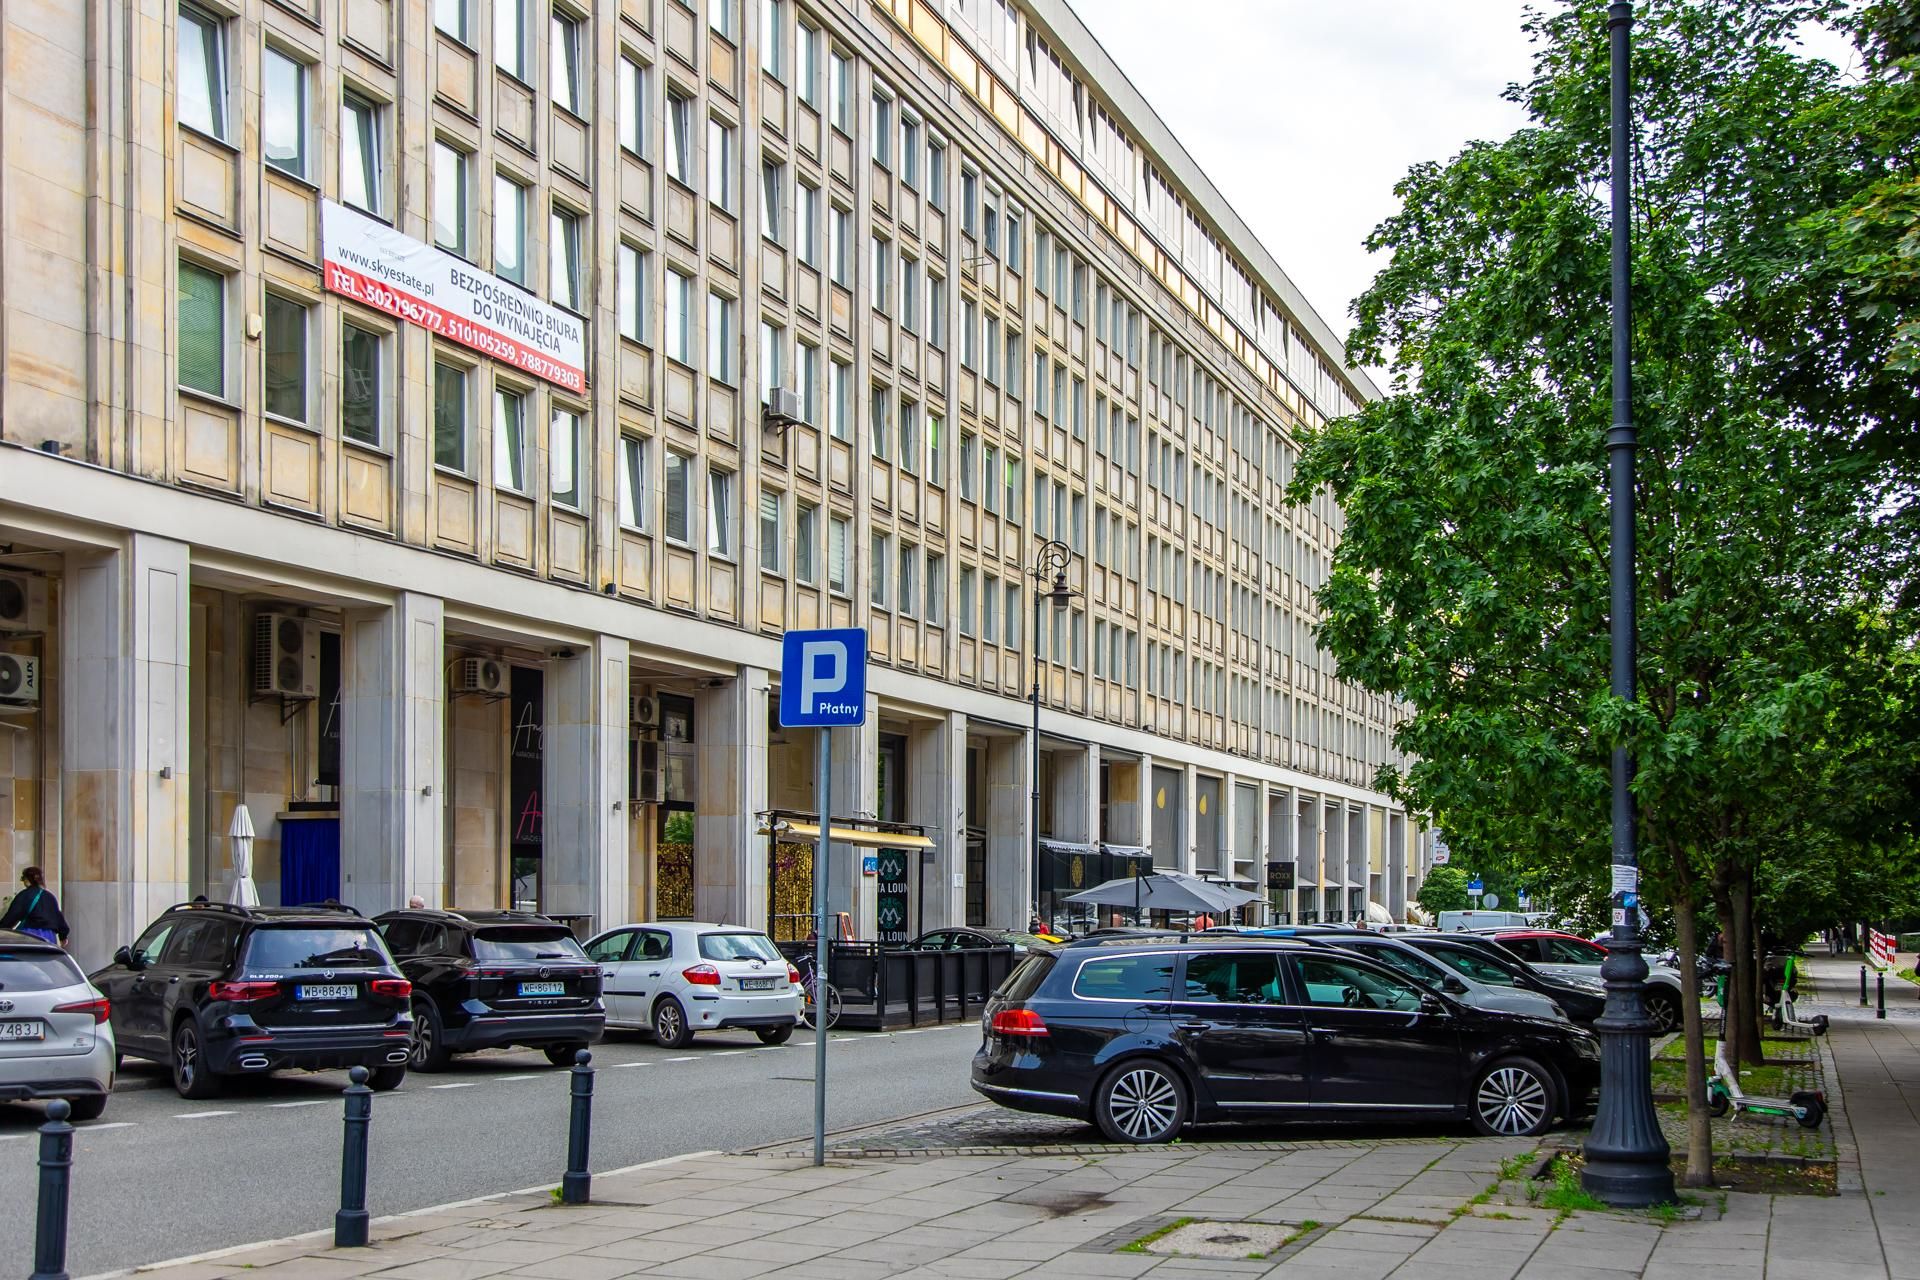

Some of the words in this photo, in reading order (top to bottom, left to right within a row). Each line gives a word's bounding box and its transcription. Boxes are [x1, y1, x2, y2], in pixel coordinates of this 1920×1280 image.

[338, 246, 434, 296] www.skyestate.pl
[331, 269, 363, 298] TEL.
[365, 283, 446, 335] 502196777,
[448, 320, 519, 365] 510105259,
[521, 350, 580, 388] 788779303
[450, 268, 543, 325] BEZPOŚREDNIO
[546, 315, 579, 343] BIURA
[473, 298, 492, 321] DO
[494, 307, 561, 353] WYNAJĘCIA
[26, 661, 34, 688] AUX
[801, 641, 847, 714] P
[819, 702, 858, 717] Płatny
